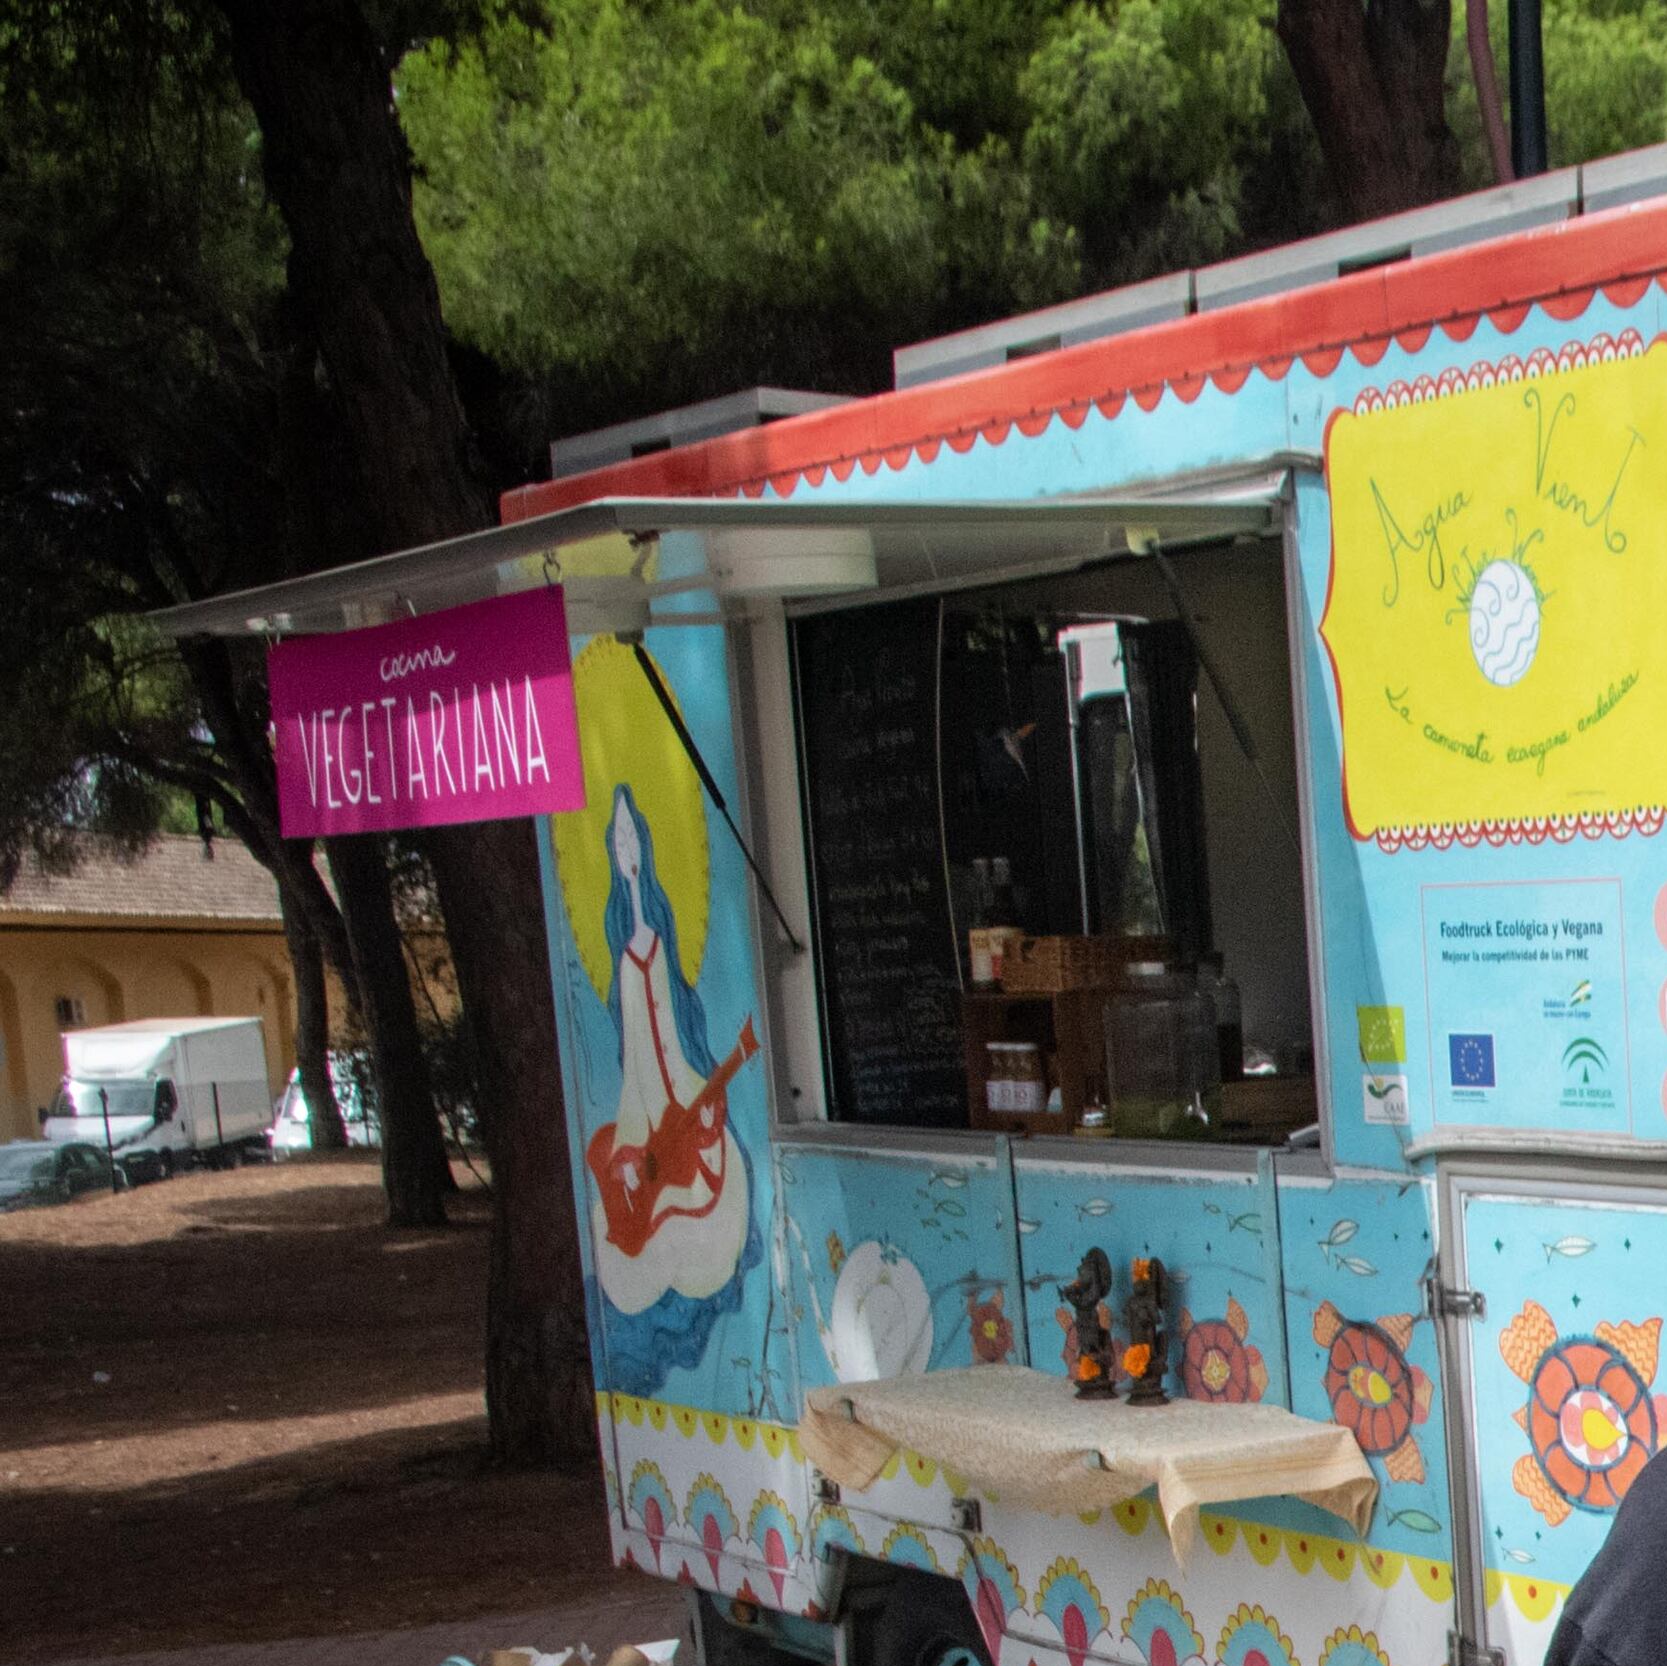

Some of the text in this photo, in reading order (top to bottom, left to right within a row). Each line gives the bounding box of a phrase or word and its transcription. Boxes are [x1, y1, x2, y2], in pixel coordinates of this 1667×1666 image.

[1369, 476, 1474, 607] Agua
[380, 645, 456, 681] cocina
[1385, 686, 1414, 725] La
[1578, 670, 1639, 732] andaluza
[298, 674, 550, 808] VEGETARIANA
[1440, 919, 1603, 941] Foodtruck Ecológica y Vegana
[1442, 948, 1589, 964] Mejorar la competitividad de las PYME
